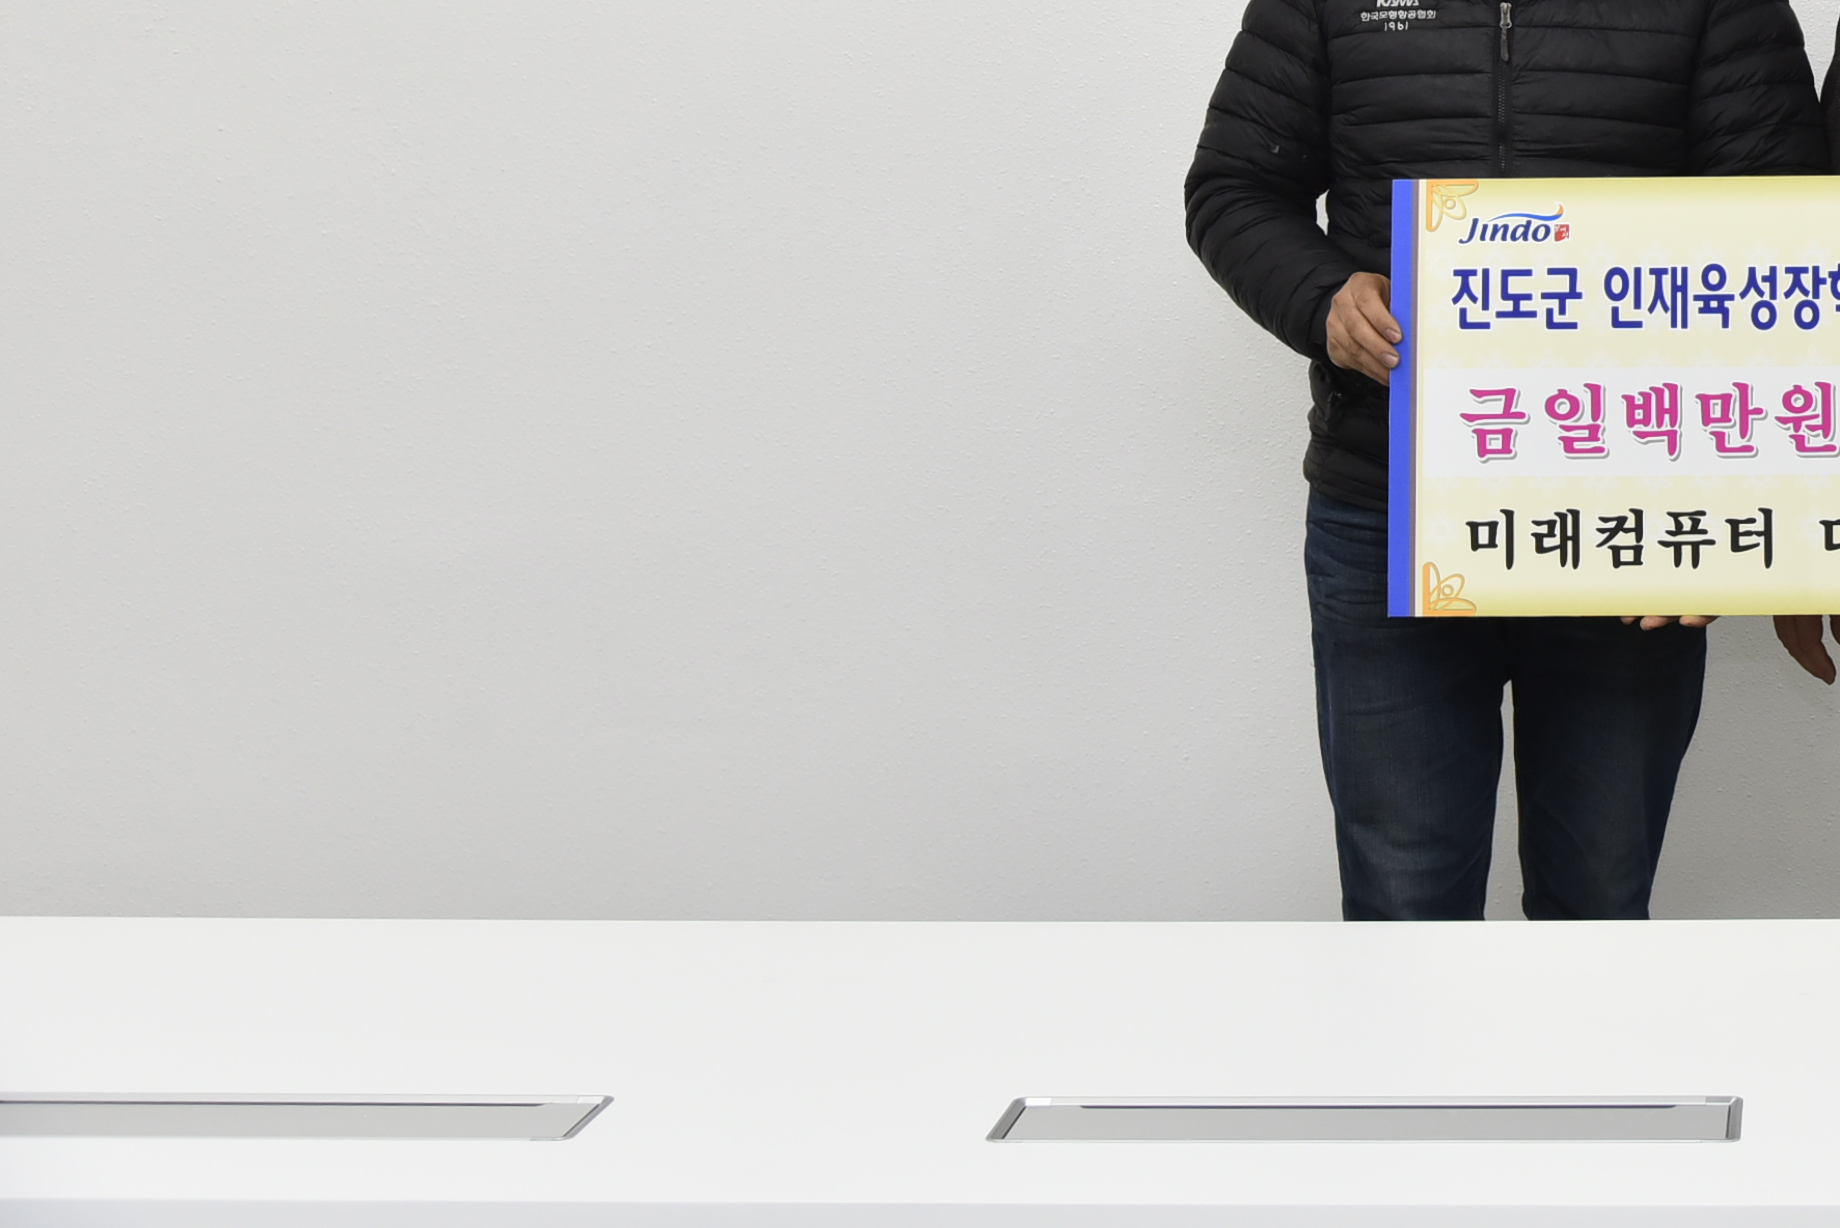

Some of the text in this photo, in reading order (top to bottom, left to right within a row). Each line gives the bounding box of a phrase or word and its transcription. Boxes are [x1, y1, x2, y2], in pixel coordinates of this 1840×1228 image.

[1384, 21, 1409, 31] 1961
[1458, 218, 1551, 245] Jindo
[1452, 267, 1584, 331] 진도군
[1465, 508, 1776, 570] 미래컴퓨터
